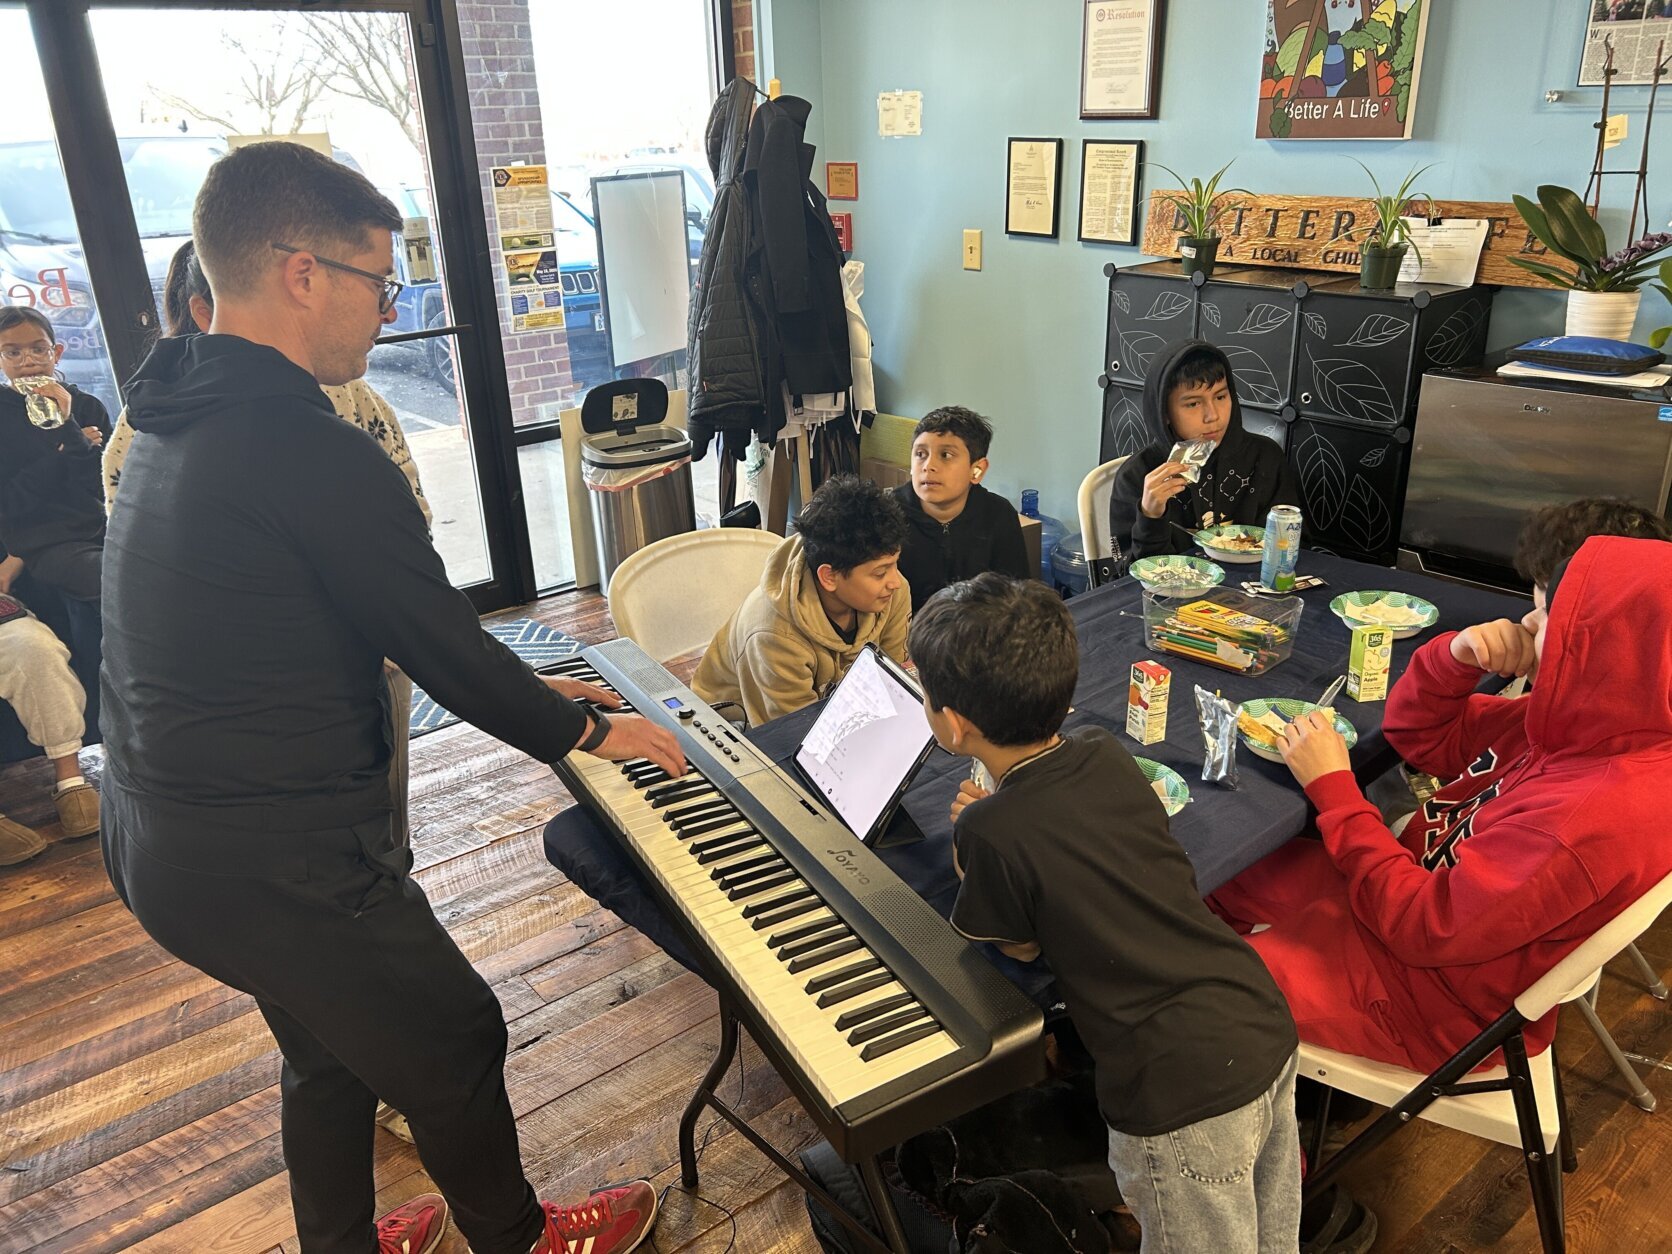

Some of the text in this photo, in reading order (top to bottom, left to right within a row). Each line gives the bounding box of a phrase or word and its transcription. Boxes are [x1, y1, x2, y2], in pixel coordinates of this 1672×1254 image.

[1107, 9, 1145, 20] Resolution
[1284, 98, 1379, 120] Better A Life
[1172, 204, 1356, 242] BTTER
[1223, 244, 1234, 257] A
[1251, 247, 1300, 264] LOCAL
[1369, 634, 1382, 643] 365
